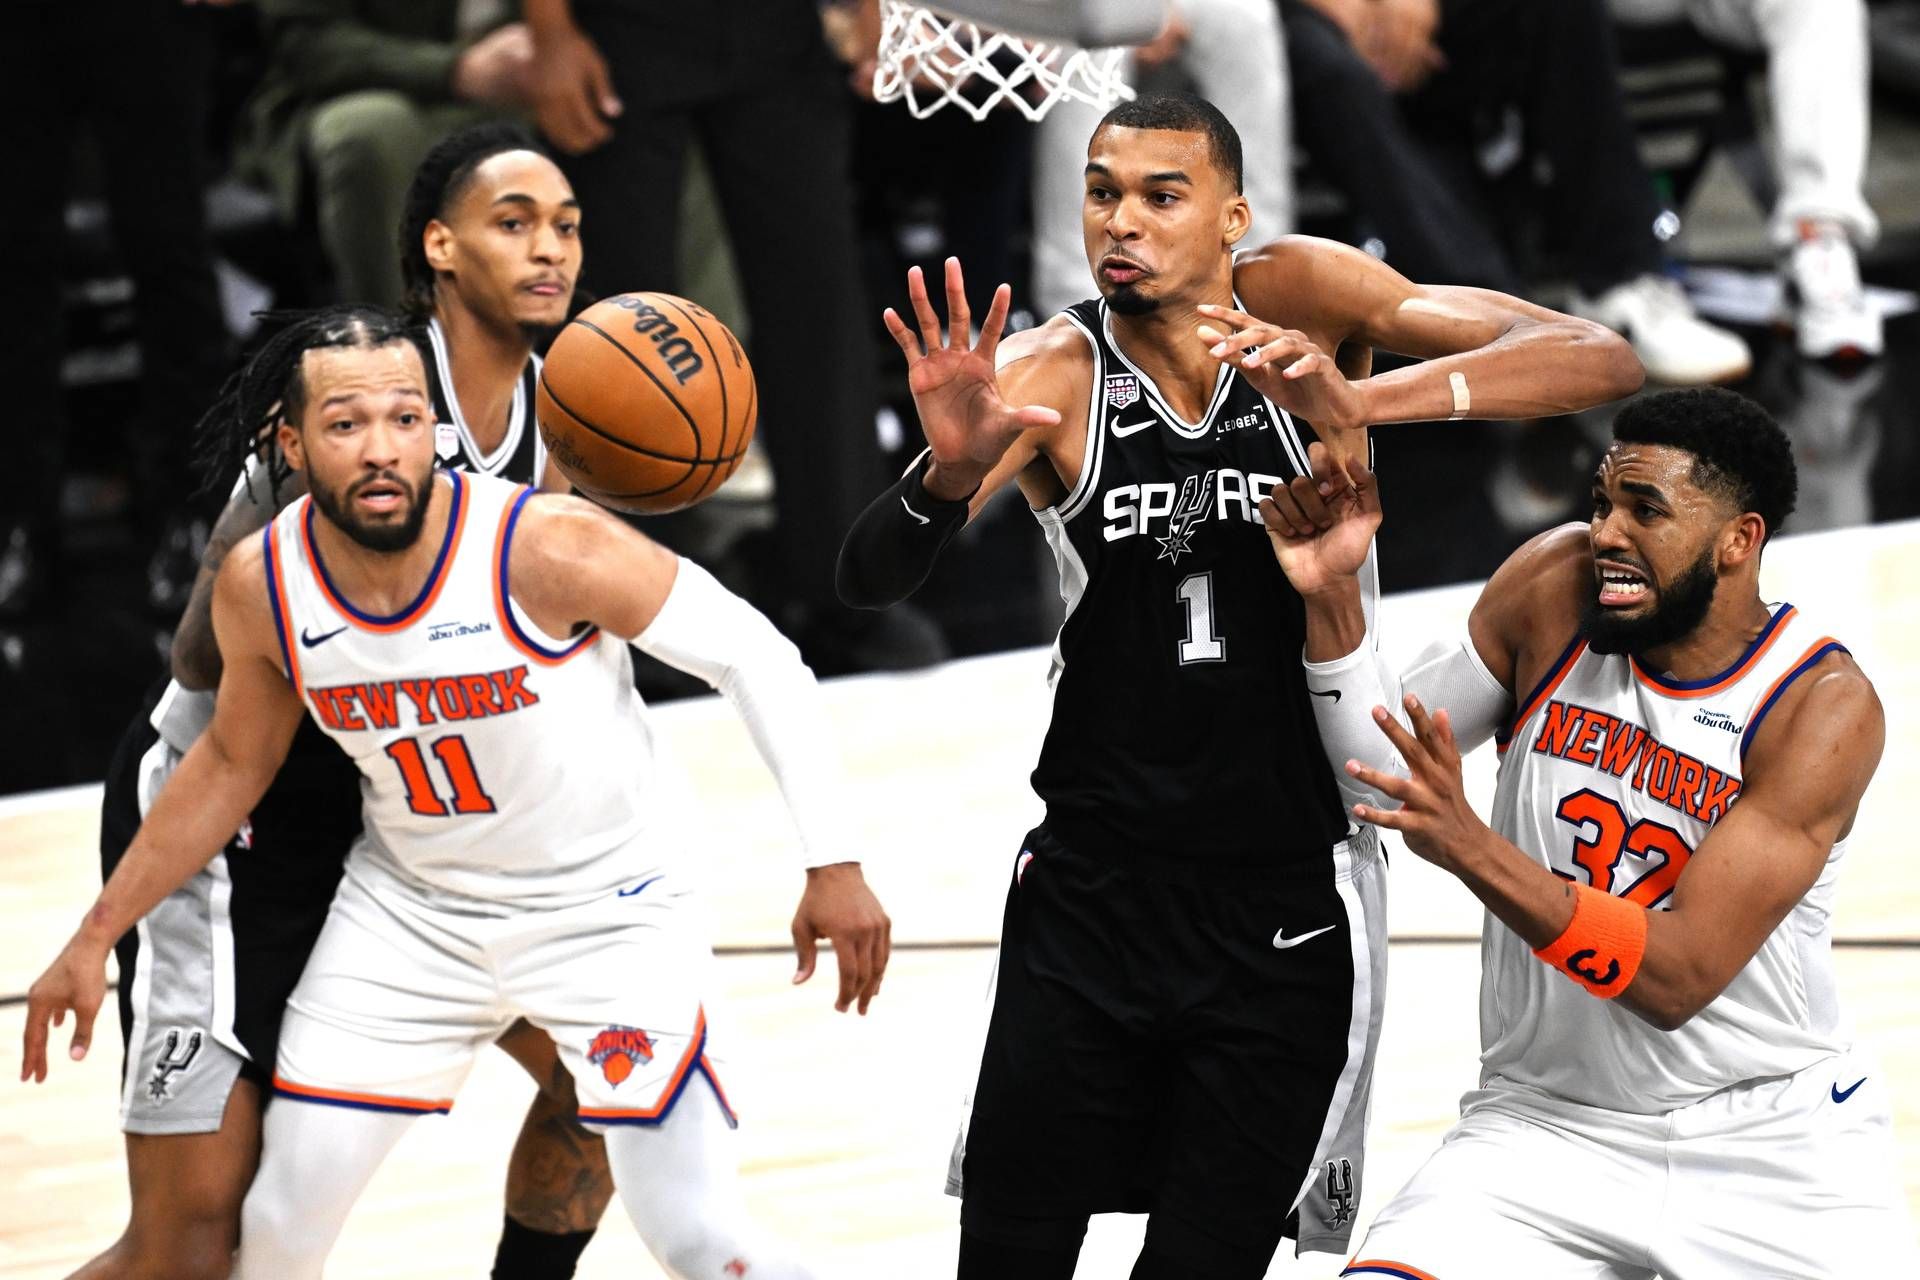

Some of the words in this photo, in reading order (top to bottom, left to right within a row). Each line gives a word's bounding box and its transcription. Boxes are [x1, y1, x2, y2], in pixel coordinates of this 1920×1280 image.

[1106, 378, 1135, 387] USA
[1107, 390, 1137, 402] 250
[1217, 413, 1258, 433] LEDGER
[1175, 570, 1227, 666] 1
[306, 681, 401, 732] NEW
[400, 664, 541, 726] YORK
[1693, 714, 1718, 728] abu
[1718, 719, 1745, 735] dha
[384, 733, 498, 818] 11
[1531, 699, 1648, 781] NEW
[1631, 734, 1744, 829] YORK
[1552, 787, 1696, 911] 32
